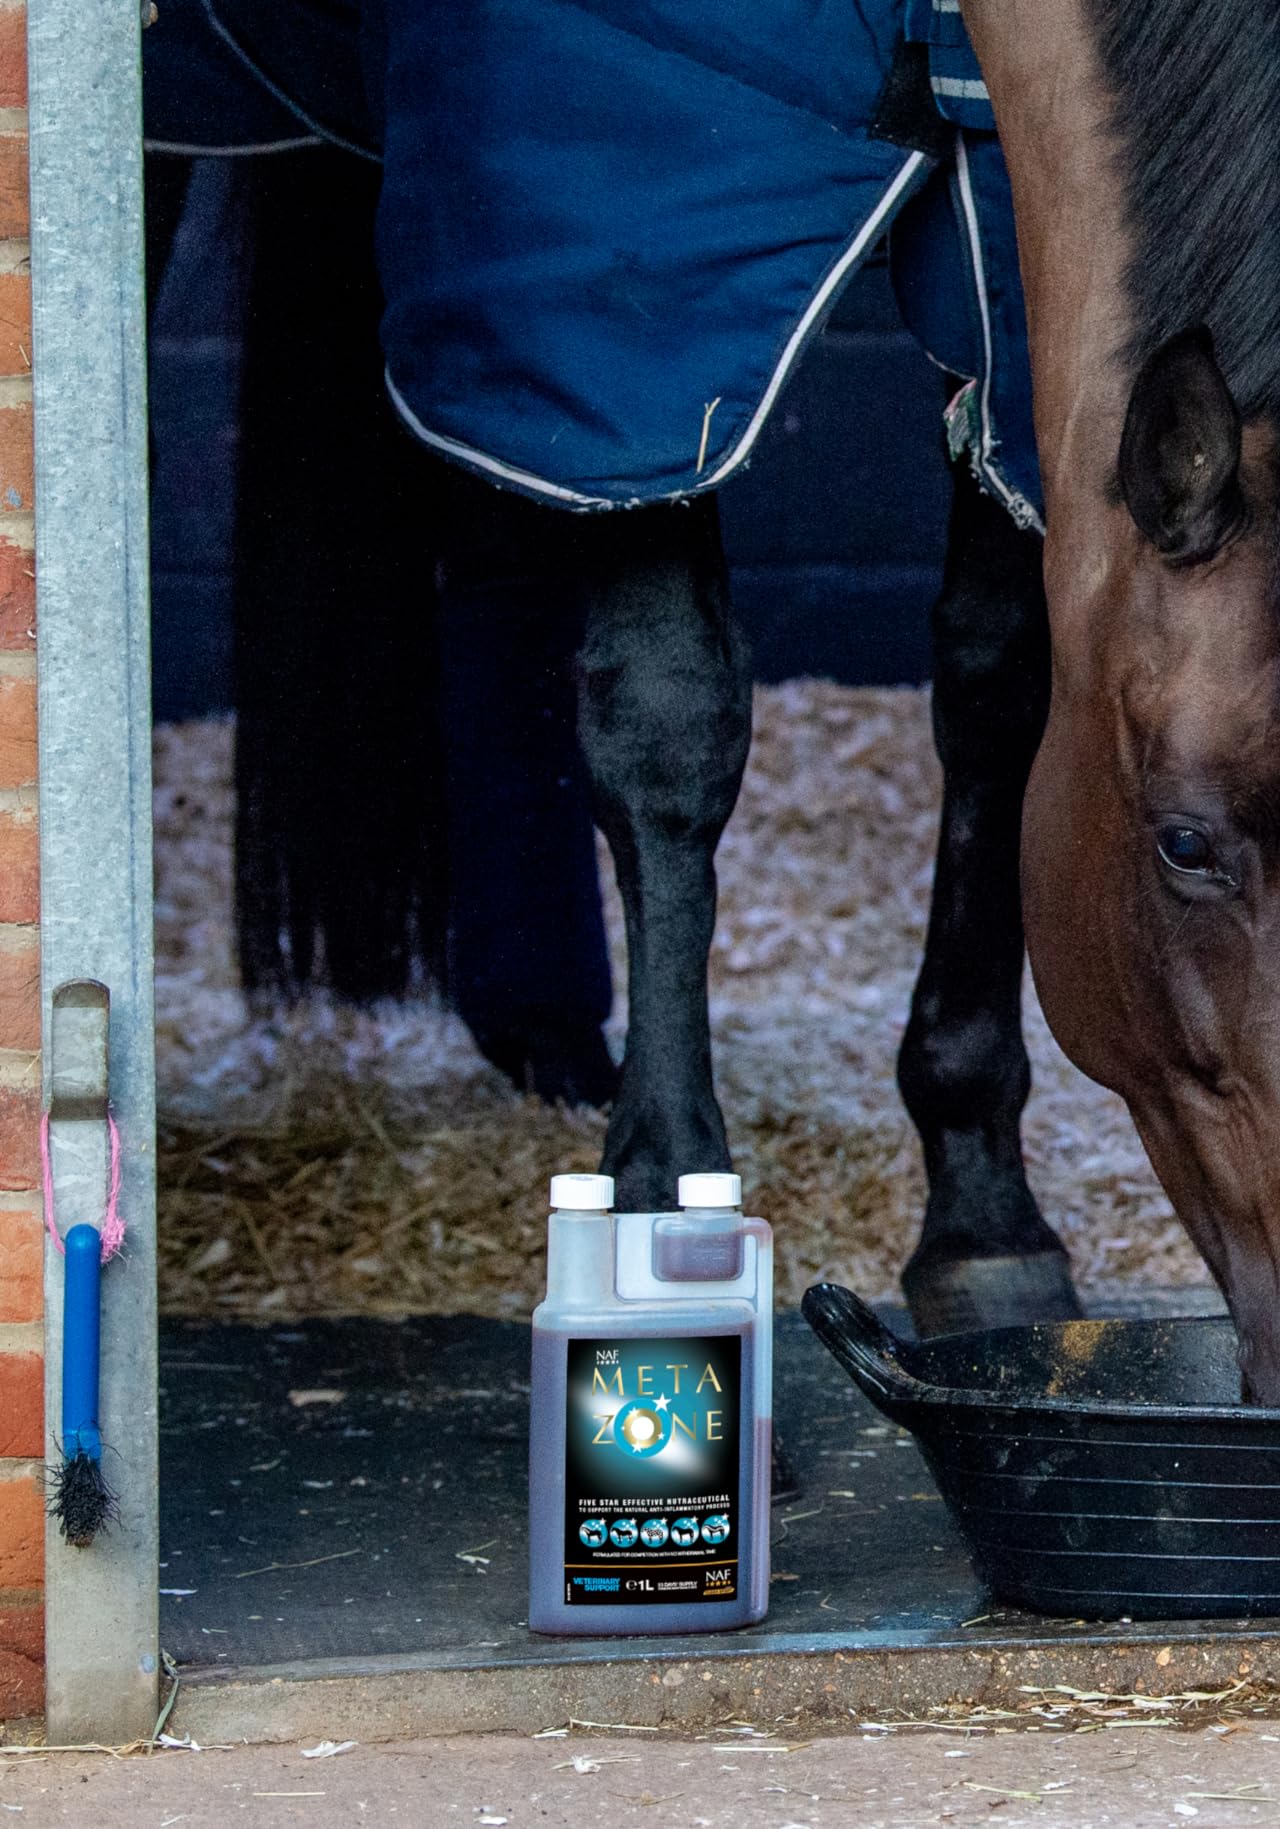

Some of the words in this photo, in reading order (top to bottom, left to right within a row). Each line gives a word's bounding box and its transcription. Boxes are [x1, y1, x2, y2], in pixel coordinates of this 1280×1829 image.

[596, 1350, 619, 1360] NAF
[592, 1363, 722, 1396] META
[592, 1409, 723, 1448] ZONE
[667, 1494, 730, 1505] NUTRACEUTICAL
[705, 1569, 731, 1582] NAF
